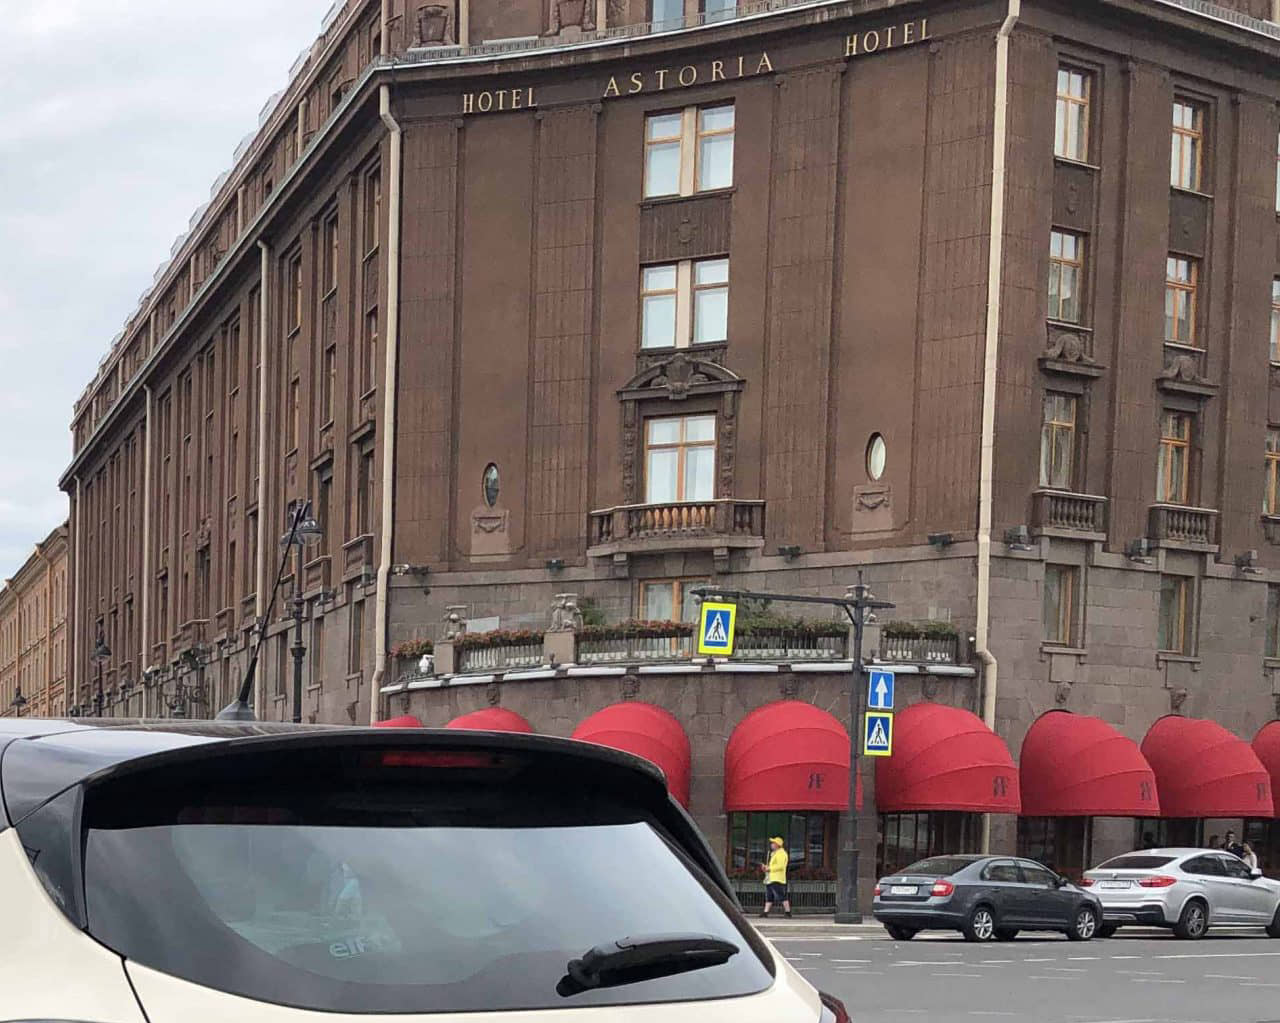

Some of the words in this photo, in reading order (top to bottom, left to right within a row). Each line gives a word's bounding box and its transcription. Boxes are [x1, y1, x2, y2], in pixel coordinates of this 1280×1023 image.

[463, 87, 538, 114] HOTEL
[603, 51, 774, 98] ASTORIA
[845, 19, 933, 57] HOTEL
